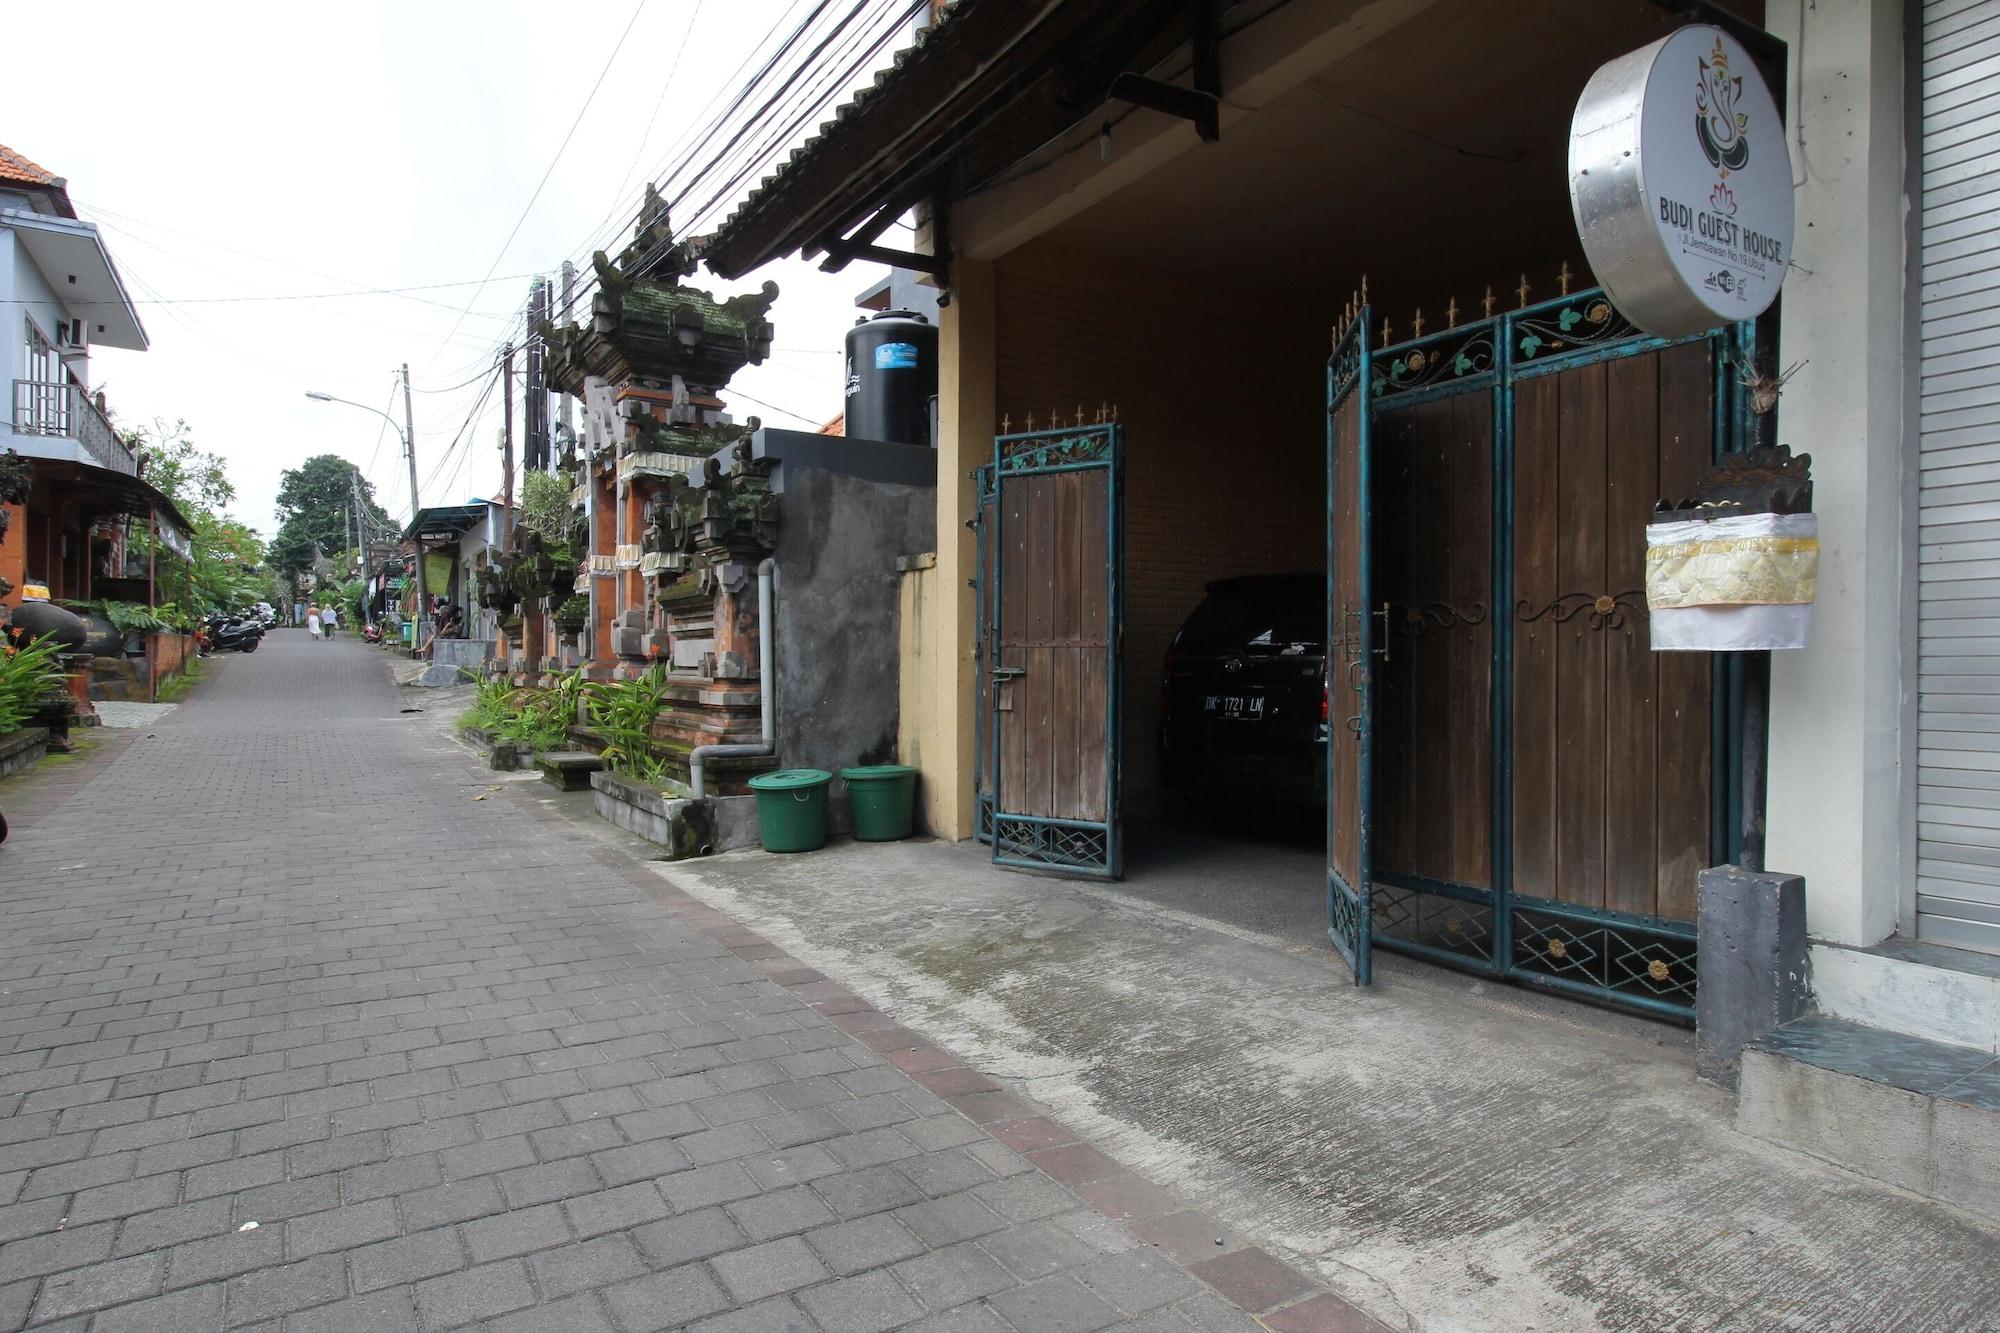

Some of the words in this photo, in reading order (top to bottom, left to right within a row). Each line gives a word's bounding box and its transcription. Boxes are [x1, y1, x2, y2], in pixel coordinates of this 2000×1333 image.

[1660, 197, 1693, 232] BUDI
[1698, 211, 1738, 249] GUEST
[1743, 228, 1783, 264] HOUSE
[846, 383, 861, 398] guin
[1206, 696, 1217, 711] DK
[1224, 697, 1244, 712] 1721
